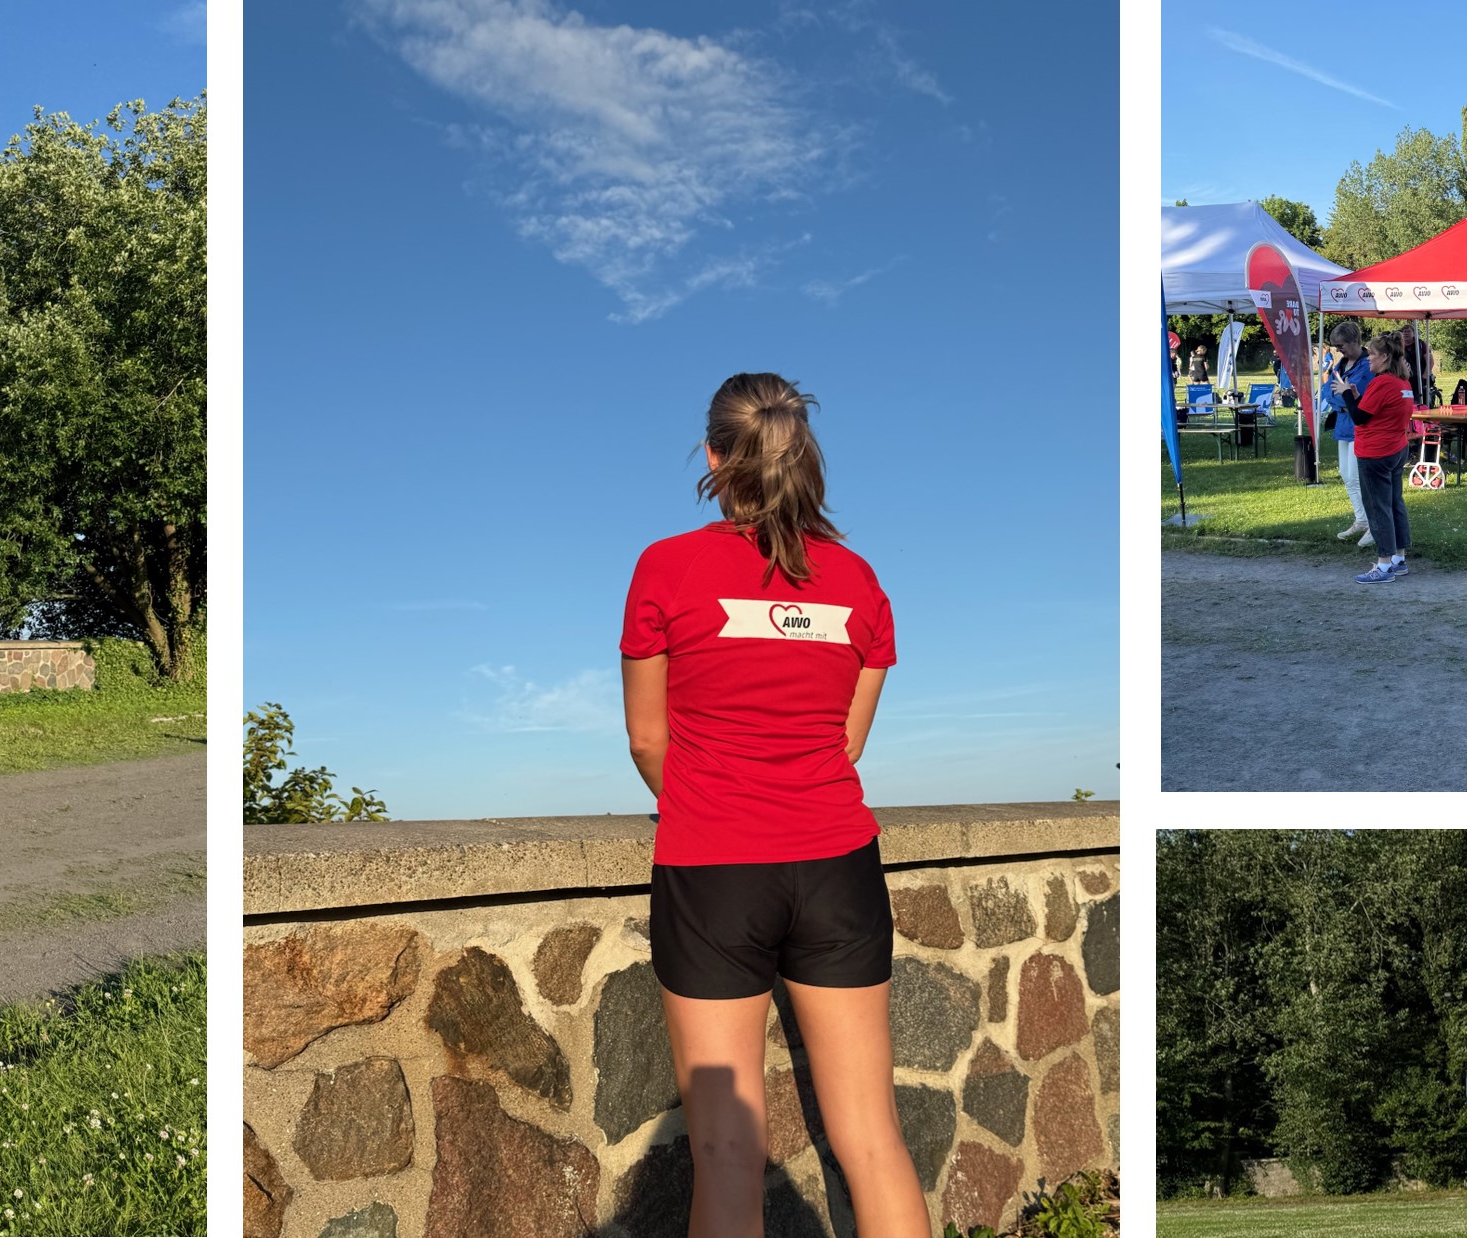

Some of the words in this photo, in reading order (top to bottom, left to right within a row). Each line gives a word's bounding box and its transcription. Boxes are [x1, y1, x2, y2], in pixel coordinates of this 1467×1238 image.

[782, 616, 811, 629] AWO
[789, 631, 813, 639] macht
[815, 632, 828, 640] mit
